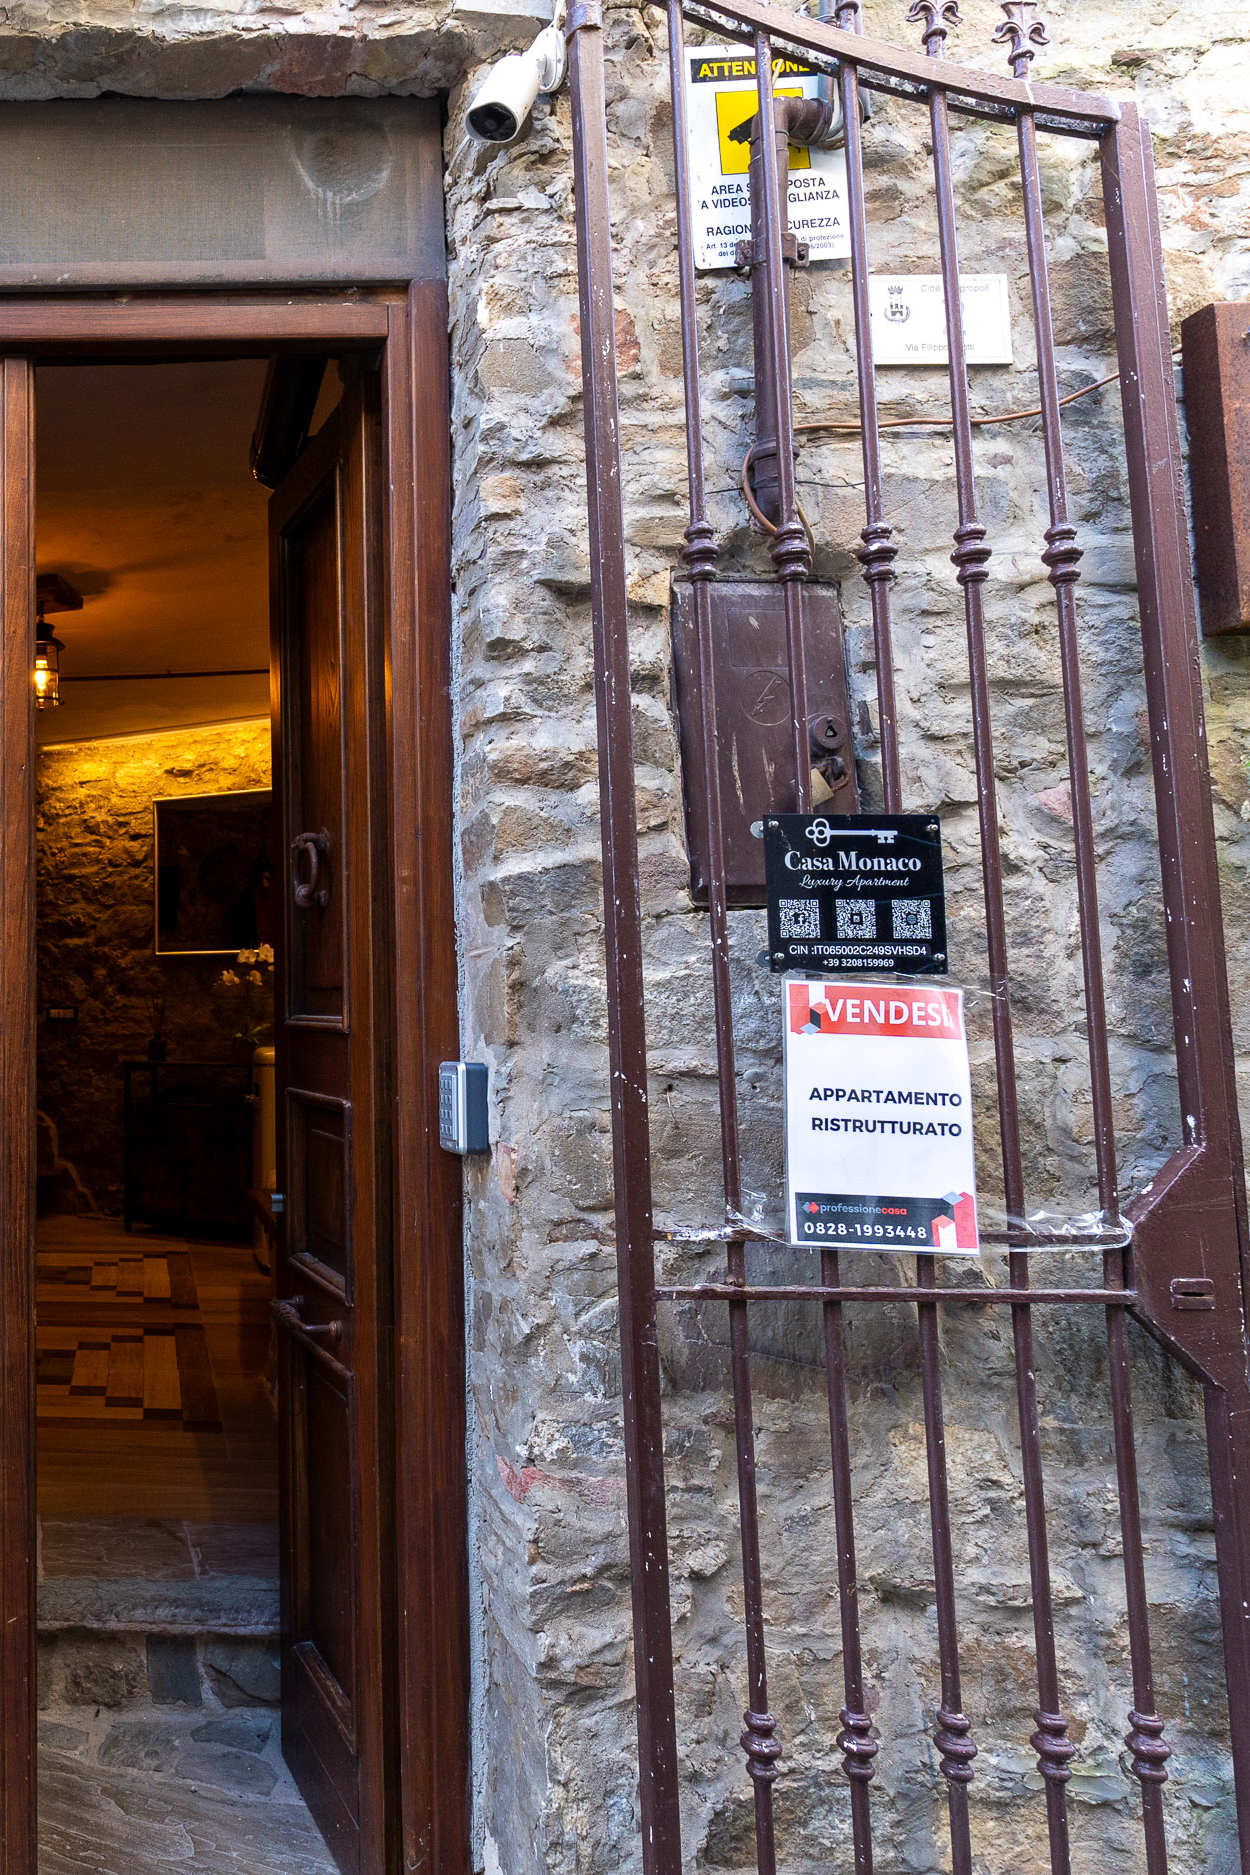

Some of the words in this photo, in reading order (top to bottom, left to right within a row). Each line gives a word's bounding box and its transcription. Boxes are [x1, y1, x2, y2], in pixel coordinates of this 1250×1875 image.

[699, 57, 811, 78] ATTENON
[710, 183, 744, 195] AREA
[700, 199, 709, 210] A
[809, 233, 845, 243] protezione
[959, 283, 990, 294] gropoli
[905, 343, 919, 352] Via
[784, 850, 836, 871] Casa
[836, 850, 922, 872] Monaco
[798, 873, 844, 892] Luxury
[844, 873, 910, 892] Apartment
[789, 945, 809, 955] CIN
[822, 958, 840, 967] +39
[841, 958, 895, 968] 3208159969
[824, 998, 950, 1028] VENDESI
[809, 1087, 963, 1107] APPARTAMENTO
[811, 1117, 963, 1137] RISTRUTTURATO
[819, 1202, 908, 1216] professionecasa
[803, 1221, 928, 1239] 0828-1993448
